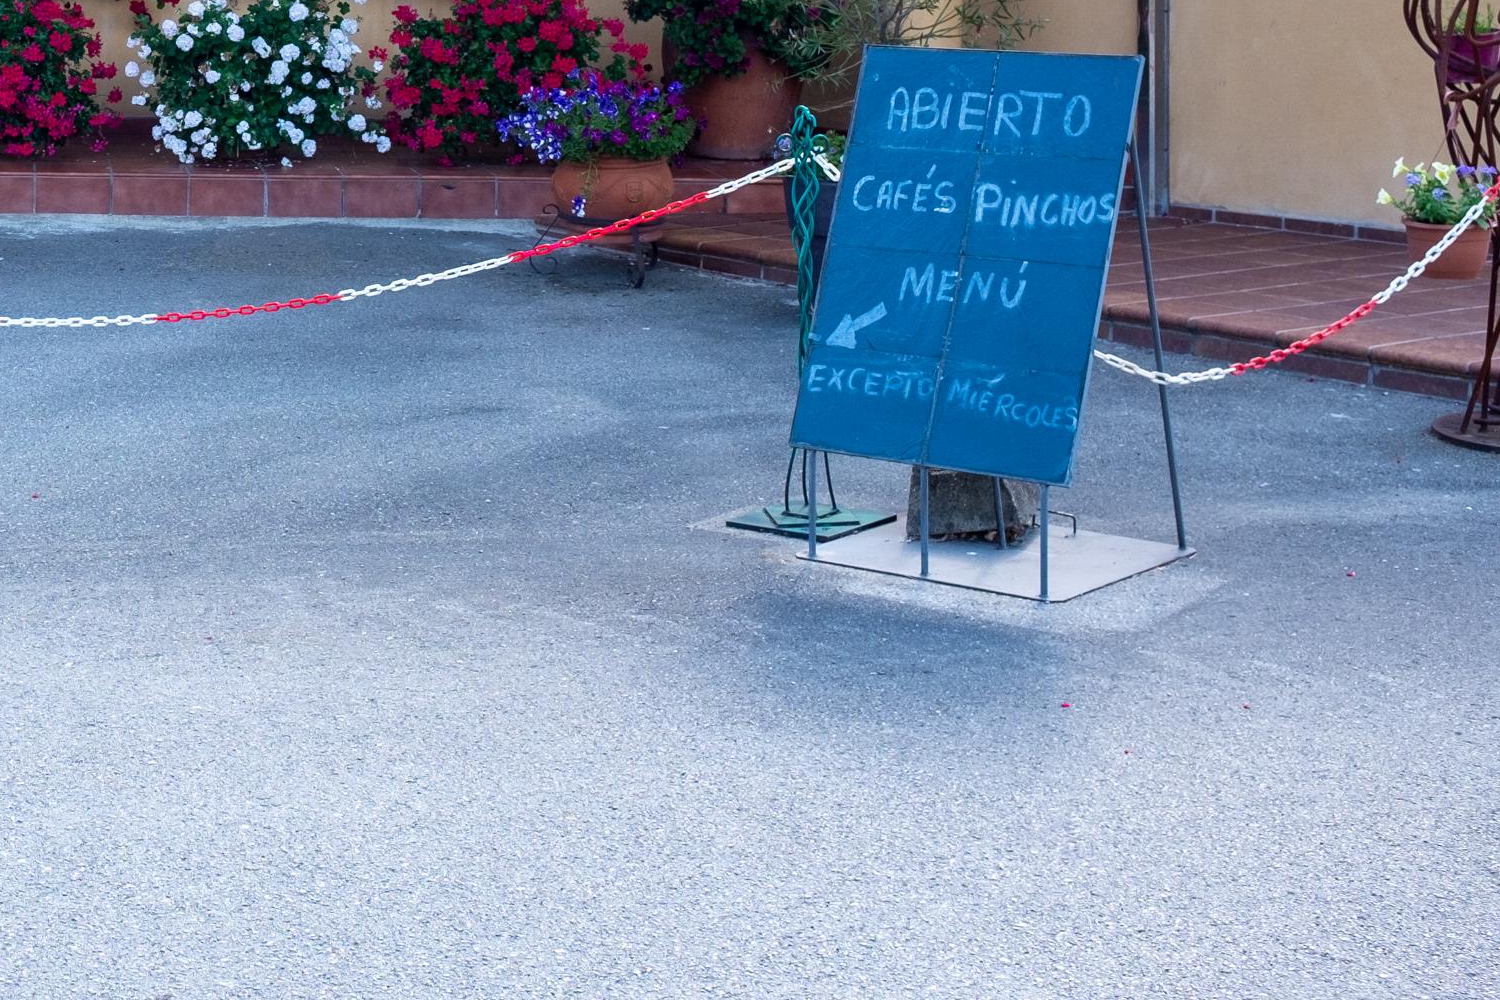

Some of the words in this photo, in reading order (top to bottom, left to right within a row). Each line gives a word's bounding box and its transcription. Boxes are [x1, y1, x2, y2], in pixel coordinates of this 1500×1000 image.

[887, 86, 1092, 138] ABIERTO
[852, 163, 957, 214] CAFÉS
[899, 260, 1029, 309] MENÚ
[807, 364, 935, 400] EXCEPTO
[949, 373, 1078, 433] MIÉRCOLES
